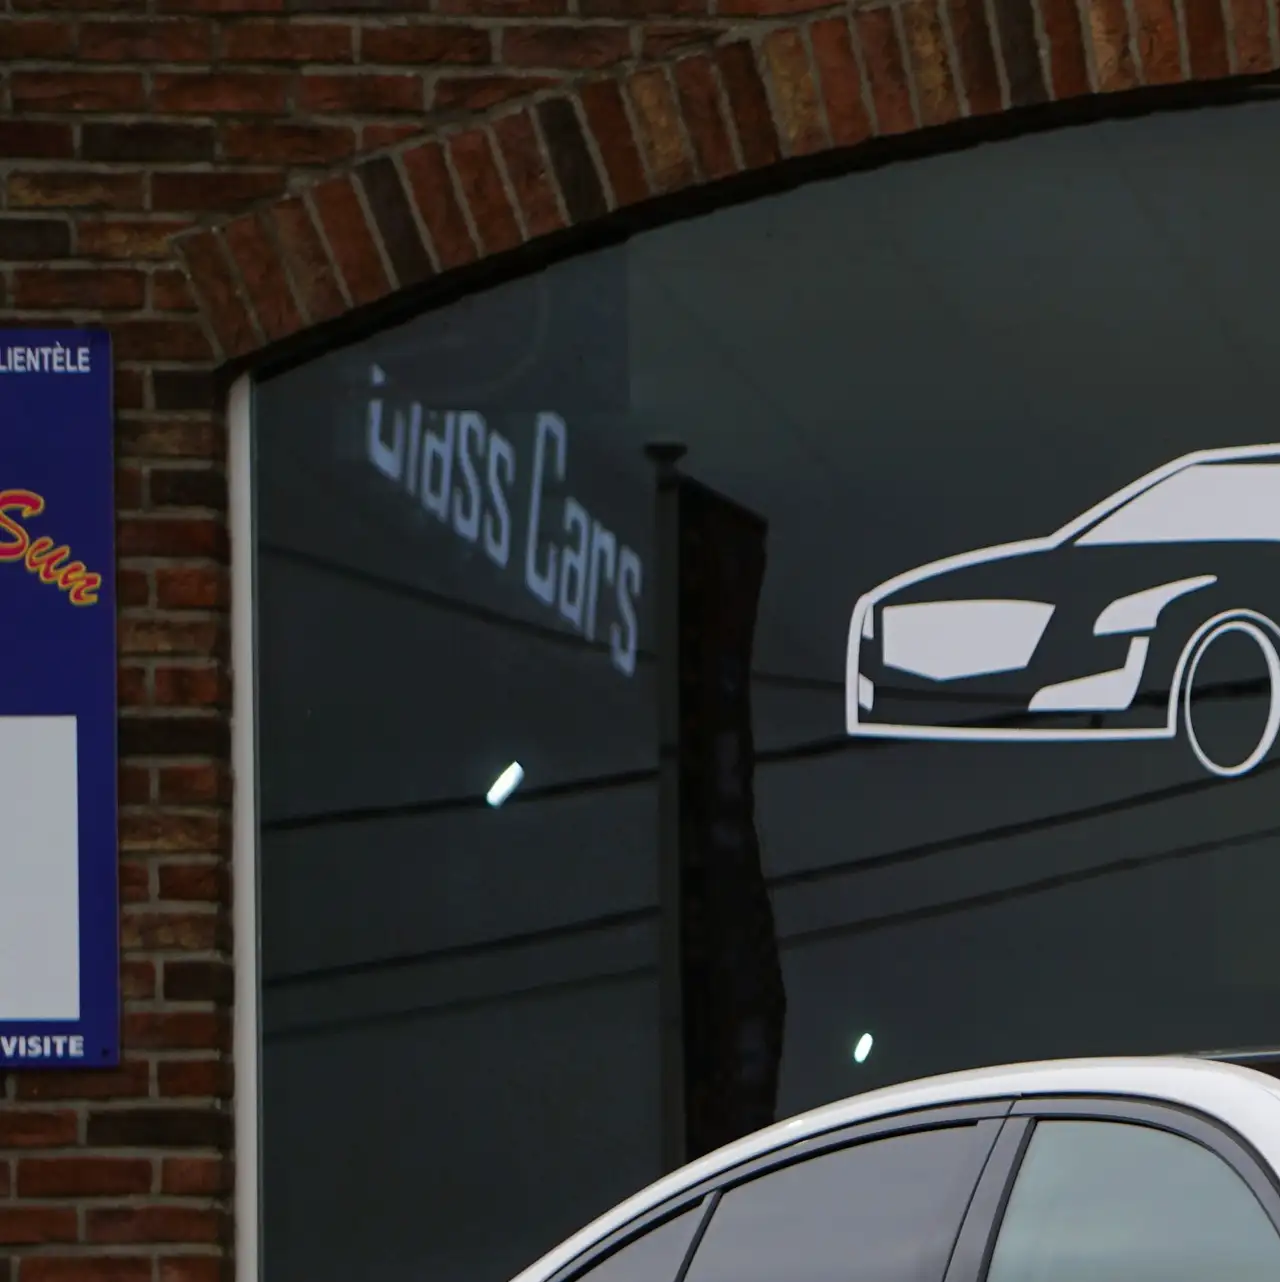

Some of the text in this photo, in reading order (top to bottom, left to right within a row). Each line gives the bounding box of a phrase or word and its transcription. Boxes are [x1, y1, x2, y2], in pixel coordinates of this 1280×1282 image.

[0, 489, 101, 605] Sun
[525, 411, 643, 677] Cars
[0, 1034, 84, 1058] VISITE
